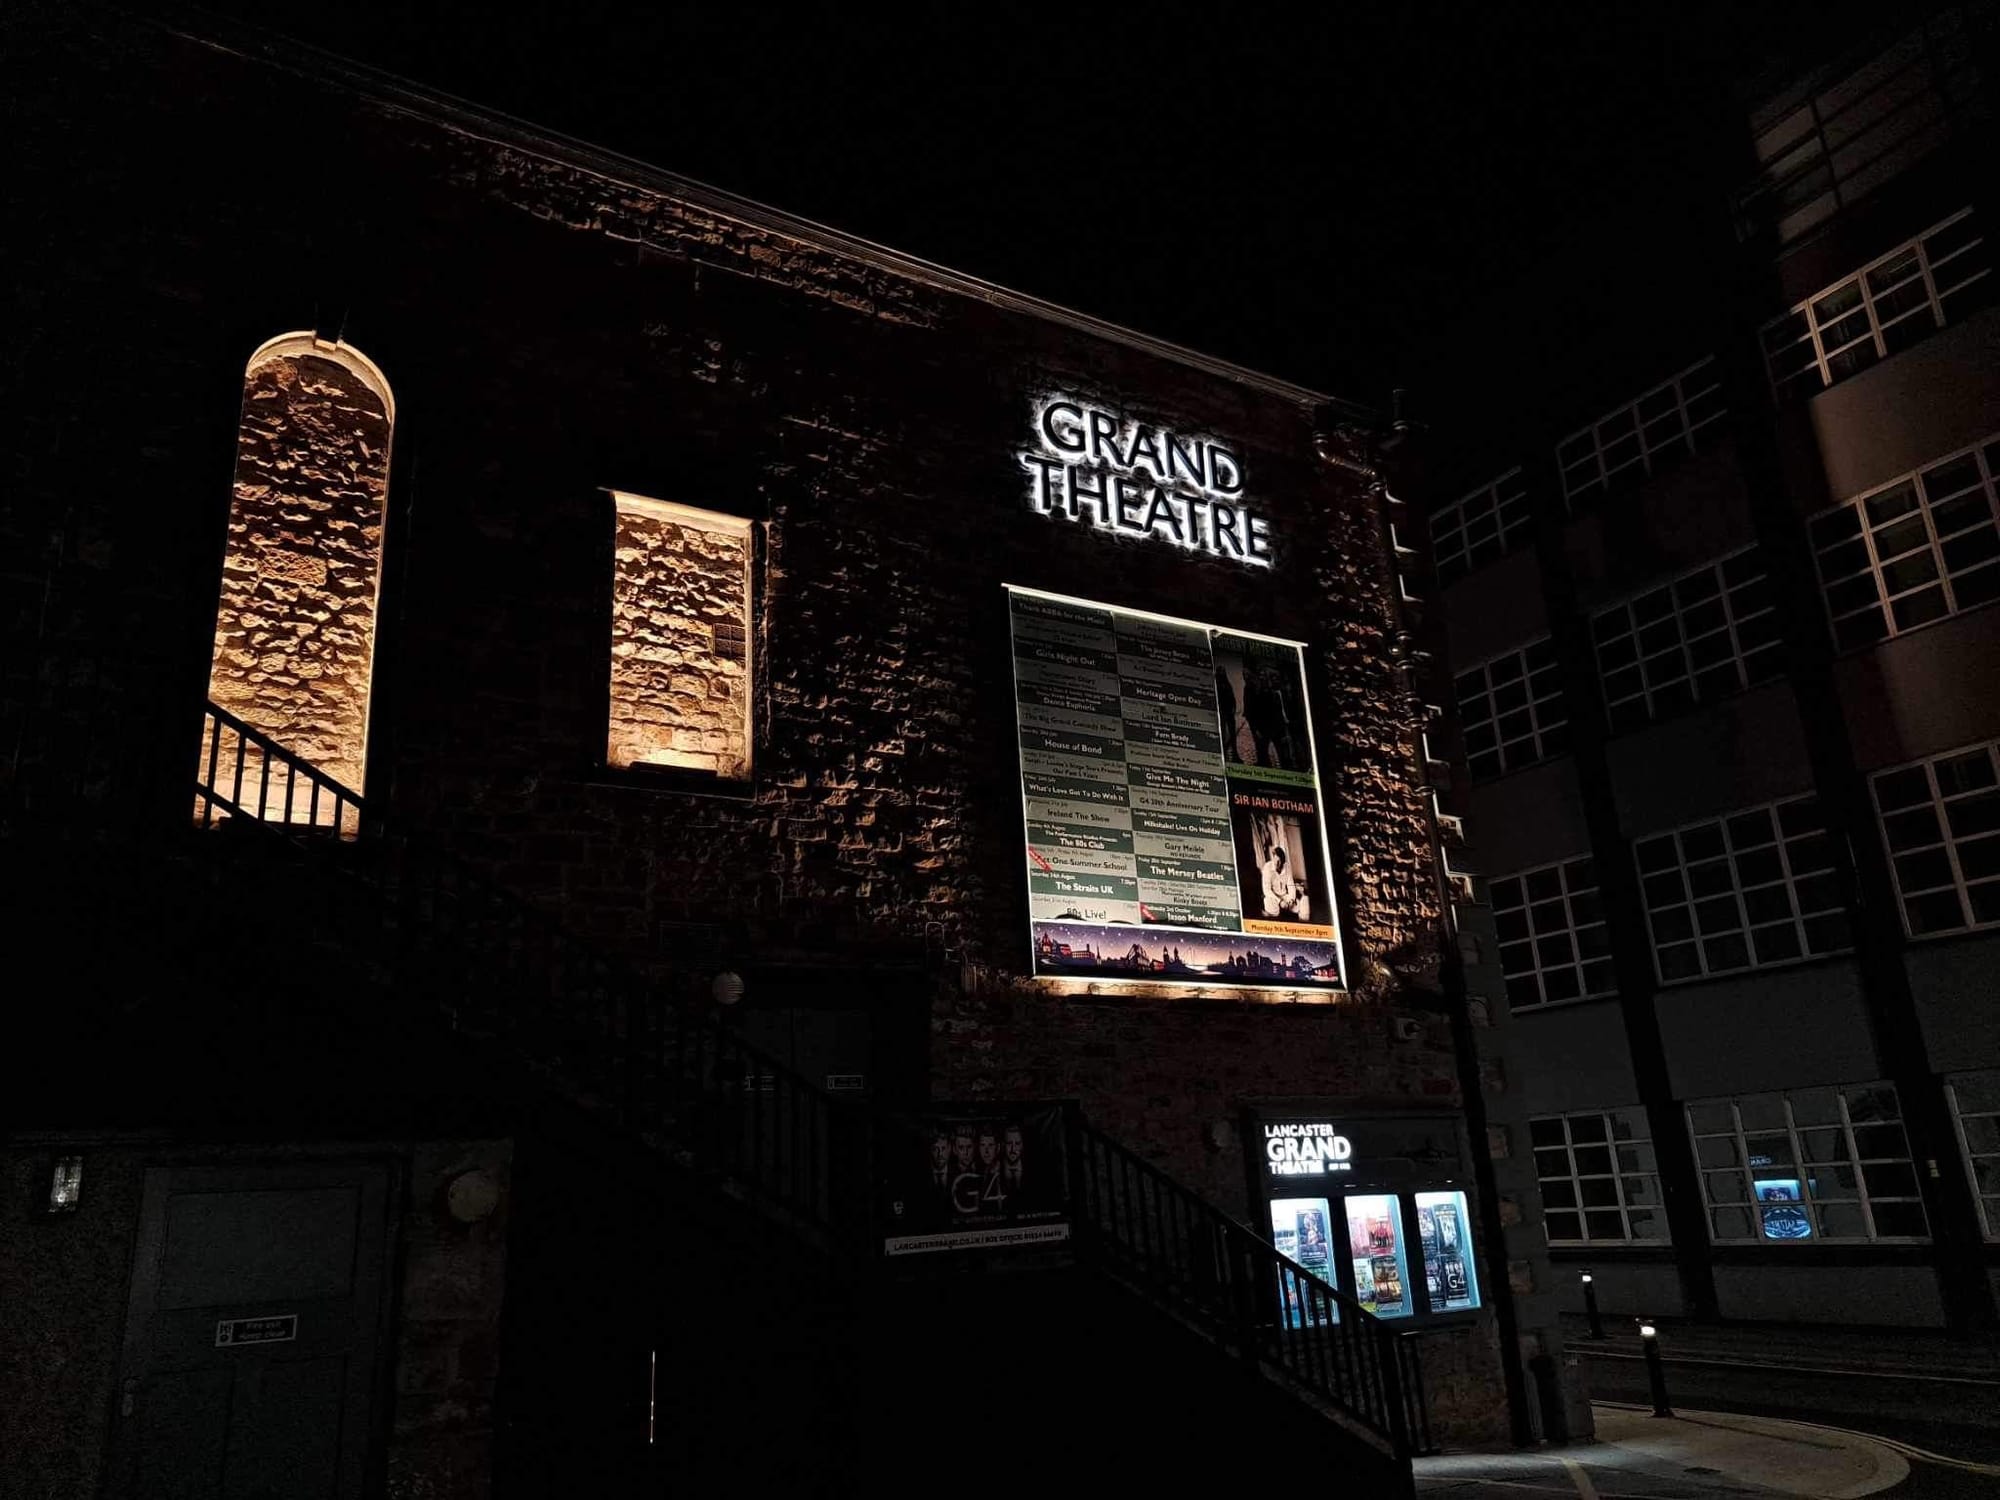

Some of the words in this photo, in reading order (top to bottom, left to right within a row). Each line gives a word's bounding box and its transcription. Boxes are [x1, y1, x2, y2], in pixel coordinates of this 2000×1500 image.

[1042, 402, 1244, 494] GRAND
[1025, 455, 1272, 562] THEATRE
[1056, 651, 1079, 665] Night
[1079, 655, 1095, 666] Out
[1135, 686, 1167, 701] Heritage
[1167, 692, 1187, 704] Open
[1187, 695, 1202, 706] Day
[1043, 696, 1065, 707] Dance
[1065, 699, 1096, 714] Euphoria
[1043, 738, 1070, 749] House
[1071, 742, 1080, 751] of
[1080, 743, 1102, 754] Bond
[1144, 771, 1162, 781] Give
[1162, 774, 1174, 782] Me
[1175, 776, 1189, 785] The
[1189, 777, 1210, 789] Night
[1028, 782, 1052, 792] What's
[1051, 785, 1068, 794] Love
[1068, 787, 1081, 796] Got
[1082, 789, 1091, 797] To
[1091, 790, 1102, 798] Do
[1101, 792, 1118, 800] With
[1139, 796, 1150, 804] G4
[1165, 799, 1204, 811] Anniversary
[1204, 804, 1220, 813] Tour
[1233, 793, 1250, 805] SIR
[1250, 795, 1269, 807] IAN
[1270, 797, 1314, 813] BOTHAM
[1046, 808, 1073, 818] Ireland
[1074, 811, 1090, 820] The
[1090, 813, 1110, 822] Show
[1143, 819, 1175, 830] Milkshake!
[1174, 823, 1187, 831] Live
[1198, 826, 1221, 836] Holiday
[1058, 837, 1074, 846] The
[1074, 839, 1088, 848] 80s
[1087, 840, 1105, 850] Club
[1163, 841, 1181, 851] Gary
[1182, 843, 1205, 852] Meikle
[1051, 856, 1069, 865] One
[1069, 857, 1102, 868] Summer
[1102, 860, 1128, 871] School
[1149, 865, 1166, 875] The
[1166, 867, 1196, 880] Mersey
[1195, 869, 1224, 880] Beatles
[1054, 880, 1072, 891] The
[1072, 882, 1099, 893] Straits
[1099, 884, 1114, 894] UK
[1172, 896, 1189, 904] Kinky
[1190, 897, 1208, 905] Boots
[1083, 908, 1107, 919] Live!
[1166, 912, 1187, 922] Jason
[1187, 913, 1217, 923] Manford
[1250, 924, 1274, 934] Monday
[1284, 926, 1316, 937] September
[1264, 1123, 1335, 1138] LANCASTER
[1266, 1135, 1352, 1162] GRAND
[1268, 1159, 1325, 1175] THEATRE
[951, 1169, 1009, 1214] G4
[1447, 1273, 1467, 1289] G4
